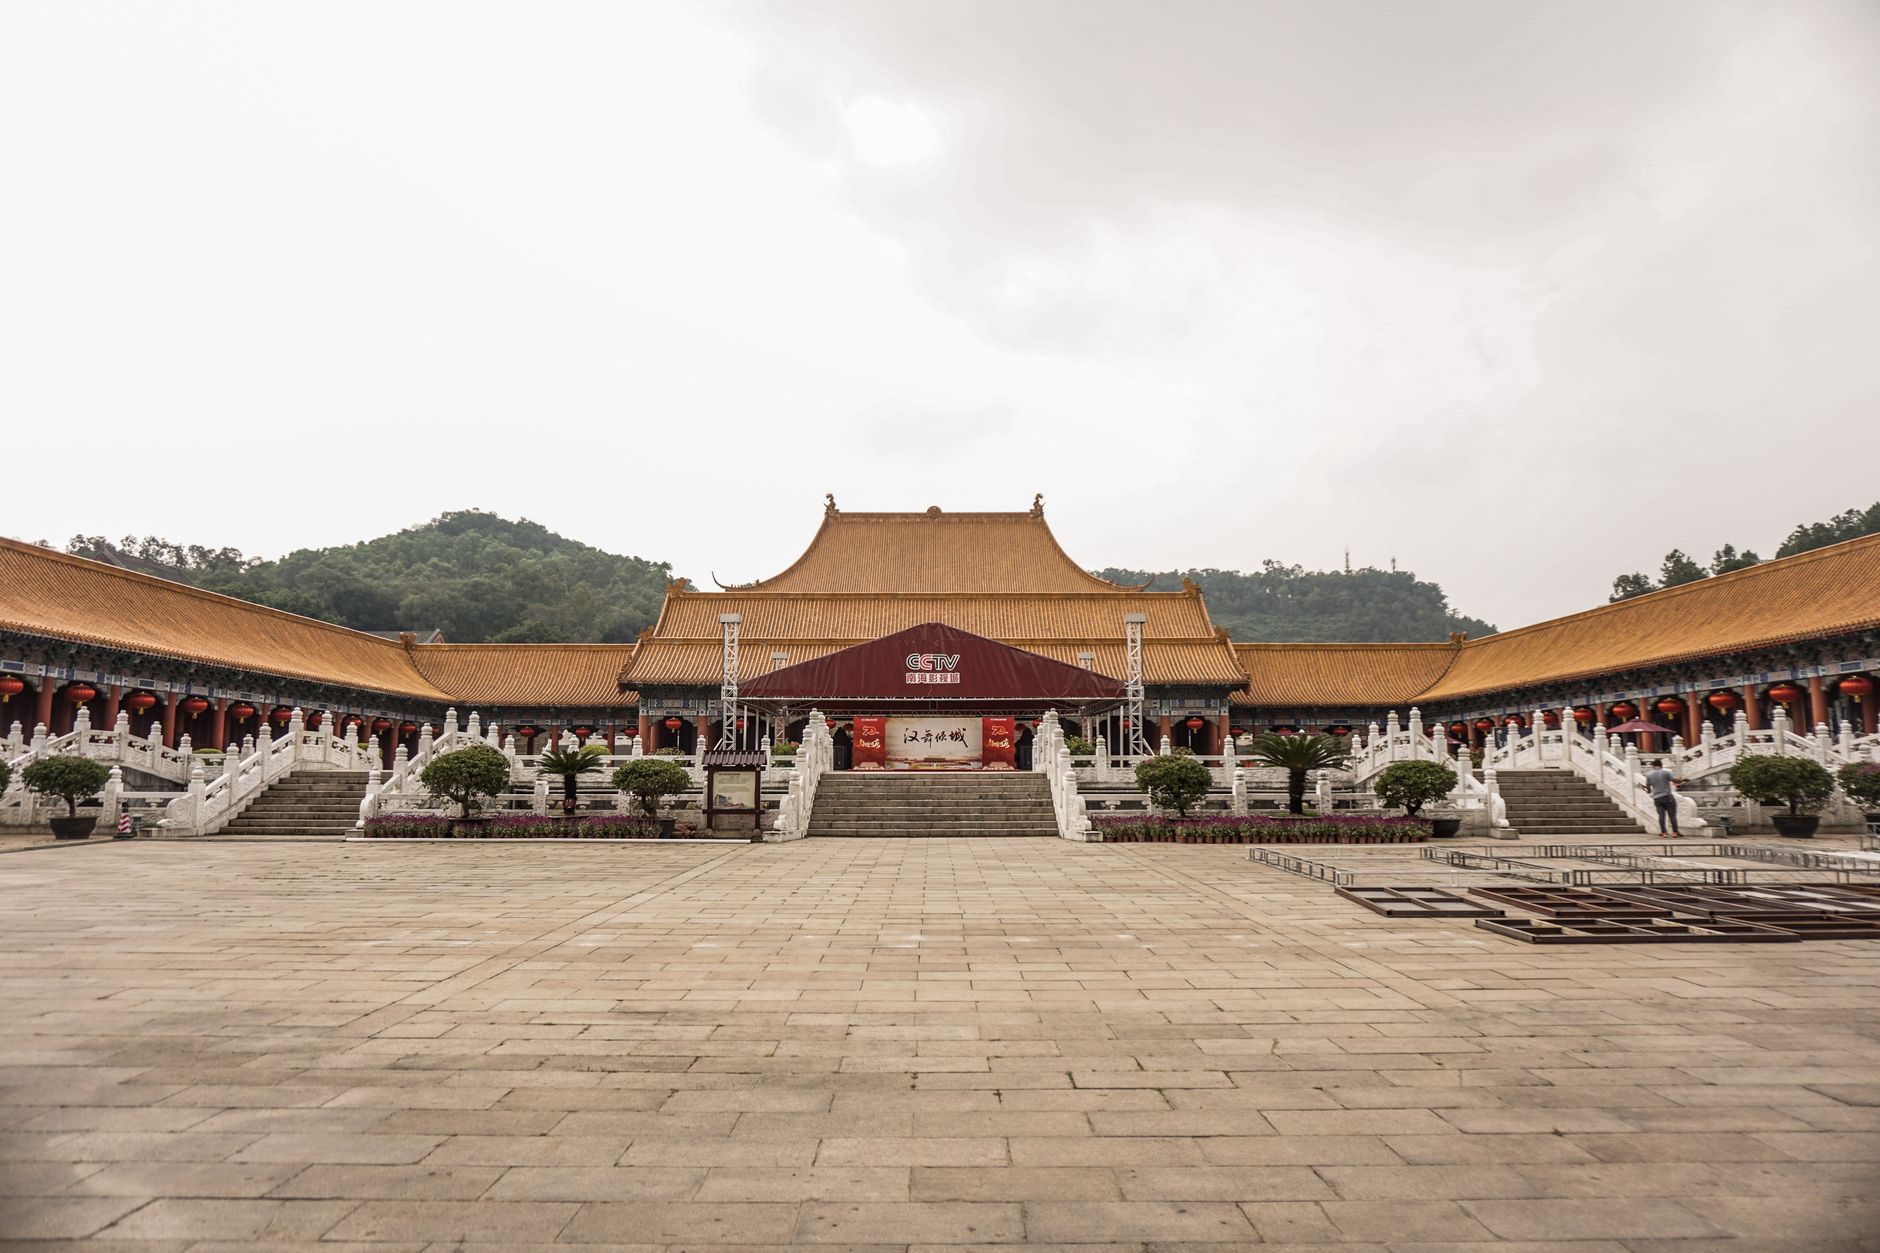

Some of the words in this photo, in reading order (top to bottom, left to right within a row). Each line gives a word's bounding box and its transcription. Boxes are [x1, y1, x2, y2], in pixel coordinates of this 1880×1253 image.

[906, 653, 960, 670] CCTV
[905, 673, 960, 684] 南海影视城
